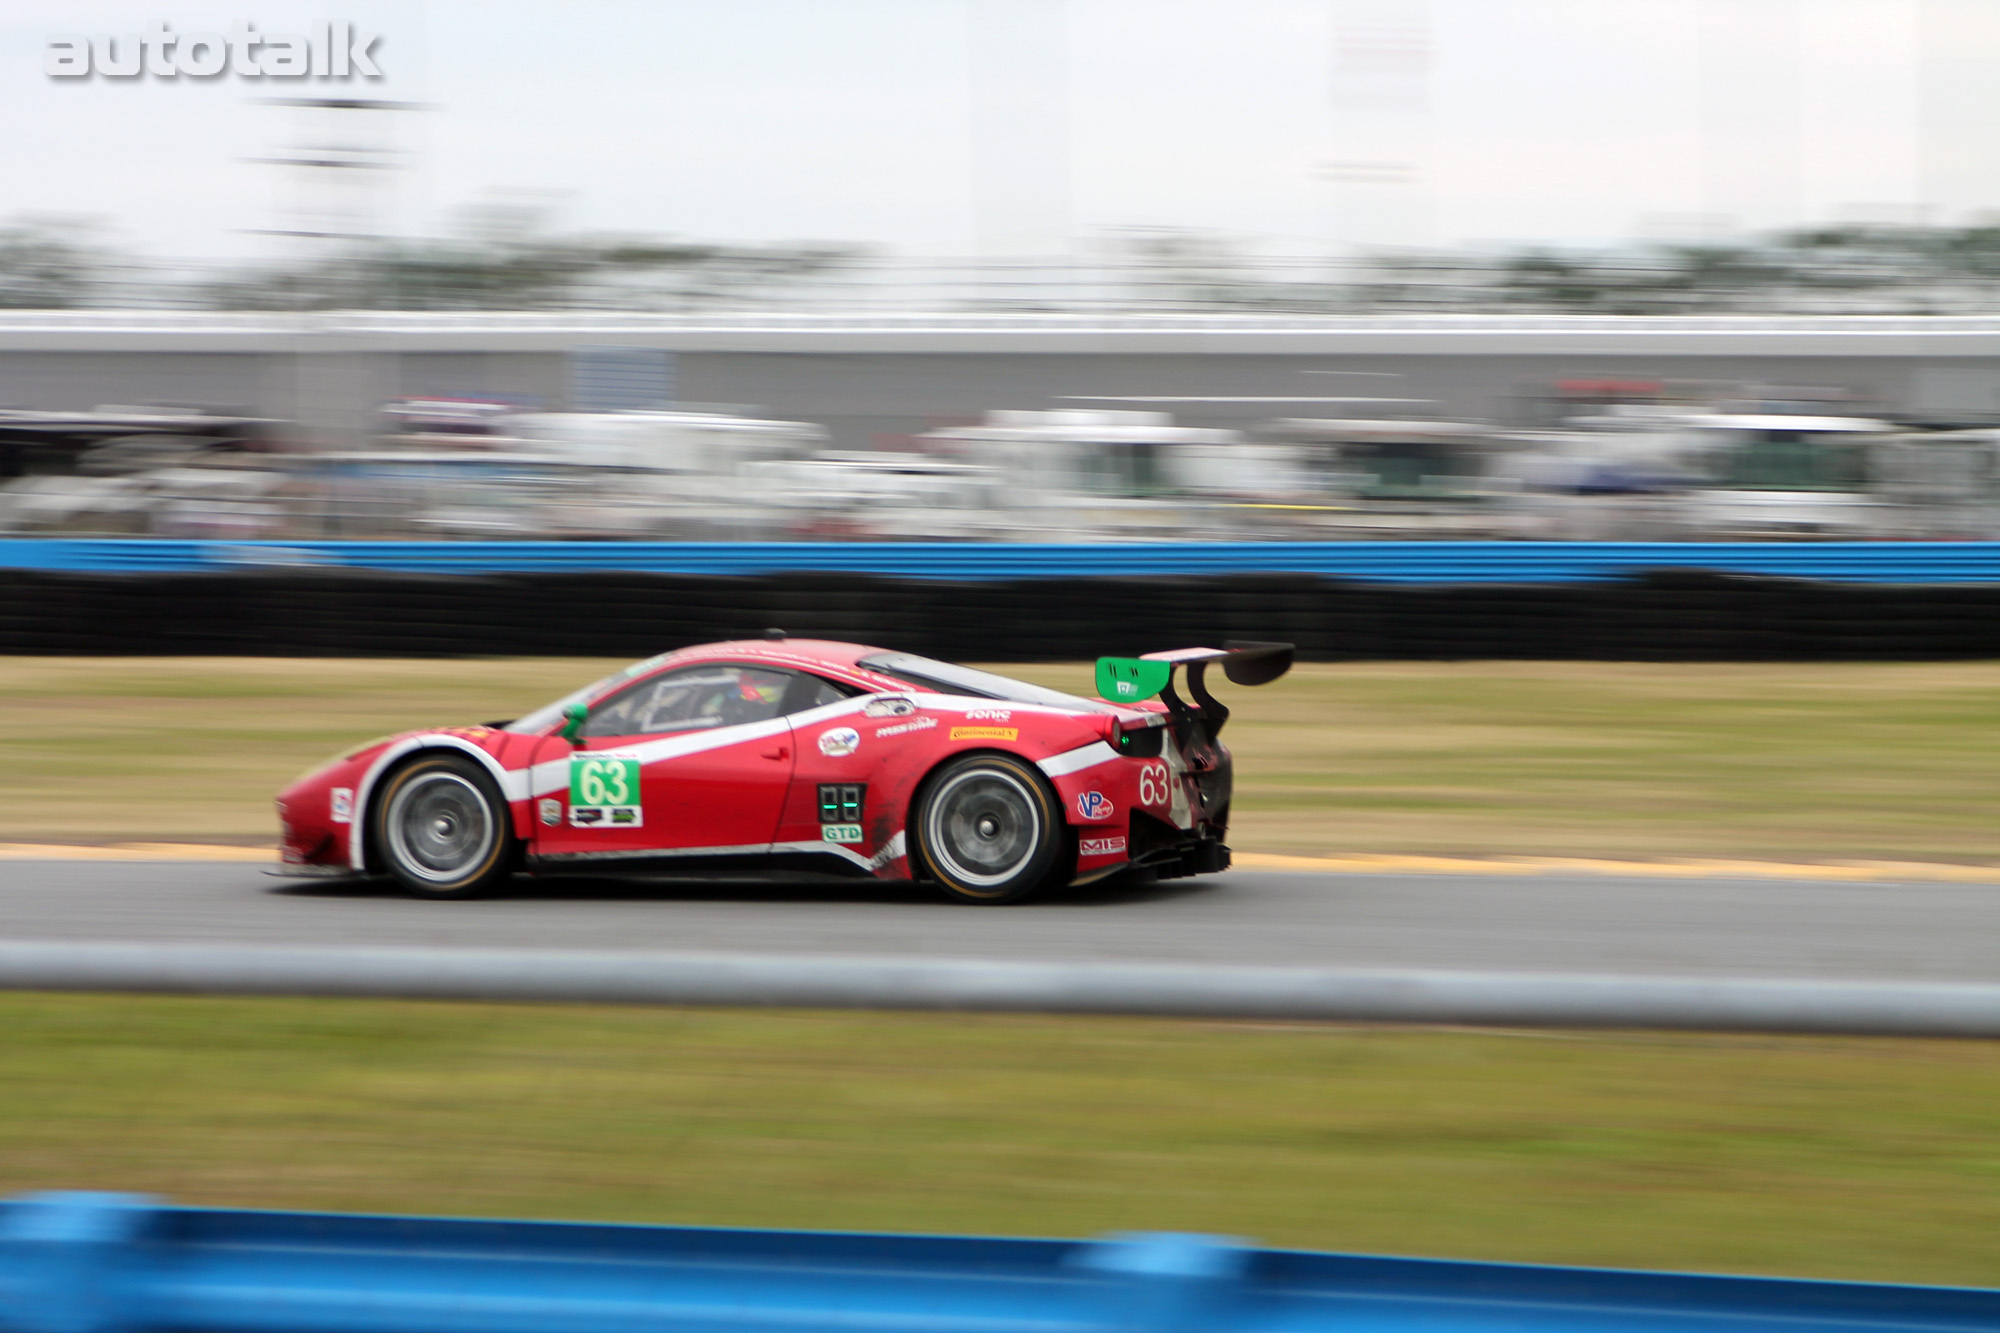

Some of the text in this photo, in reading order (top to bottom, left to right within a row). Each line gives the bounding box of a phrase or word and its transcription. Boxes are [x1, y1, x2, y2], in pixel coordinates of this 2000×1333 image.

[580, 760, 629, 806] 63
[1139, 764, 1169, 807] 63
[1078, 791, 1104, 819] VP
[824, 826, 860, 840] GTD
[1081, 838, 1125, 850] MIS
